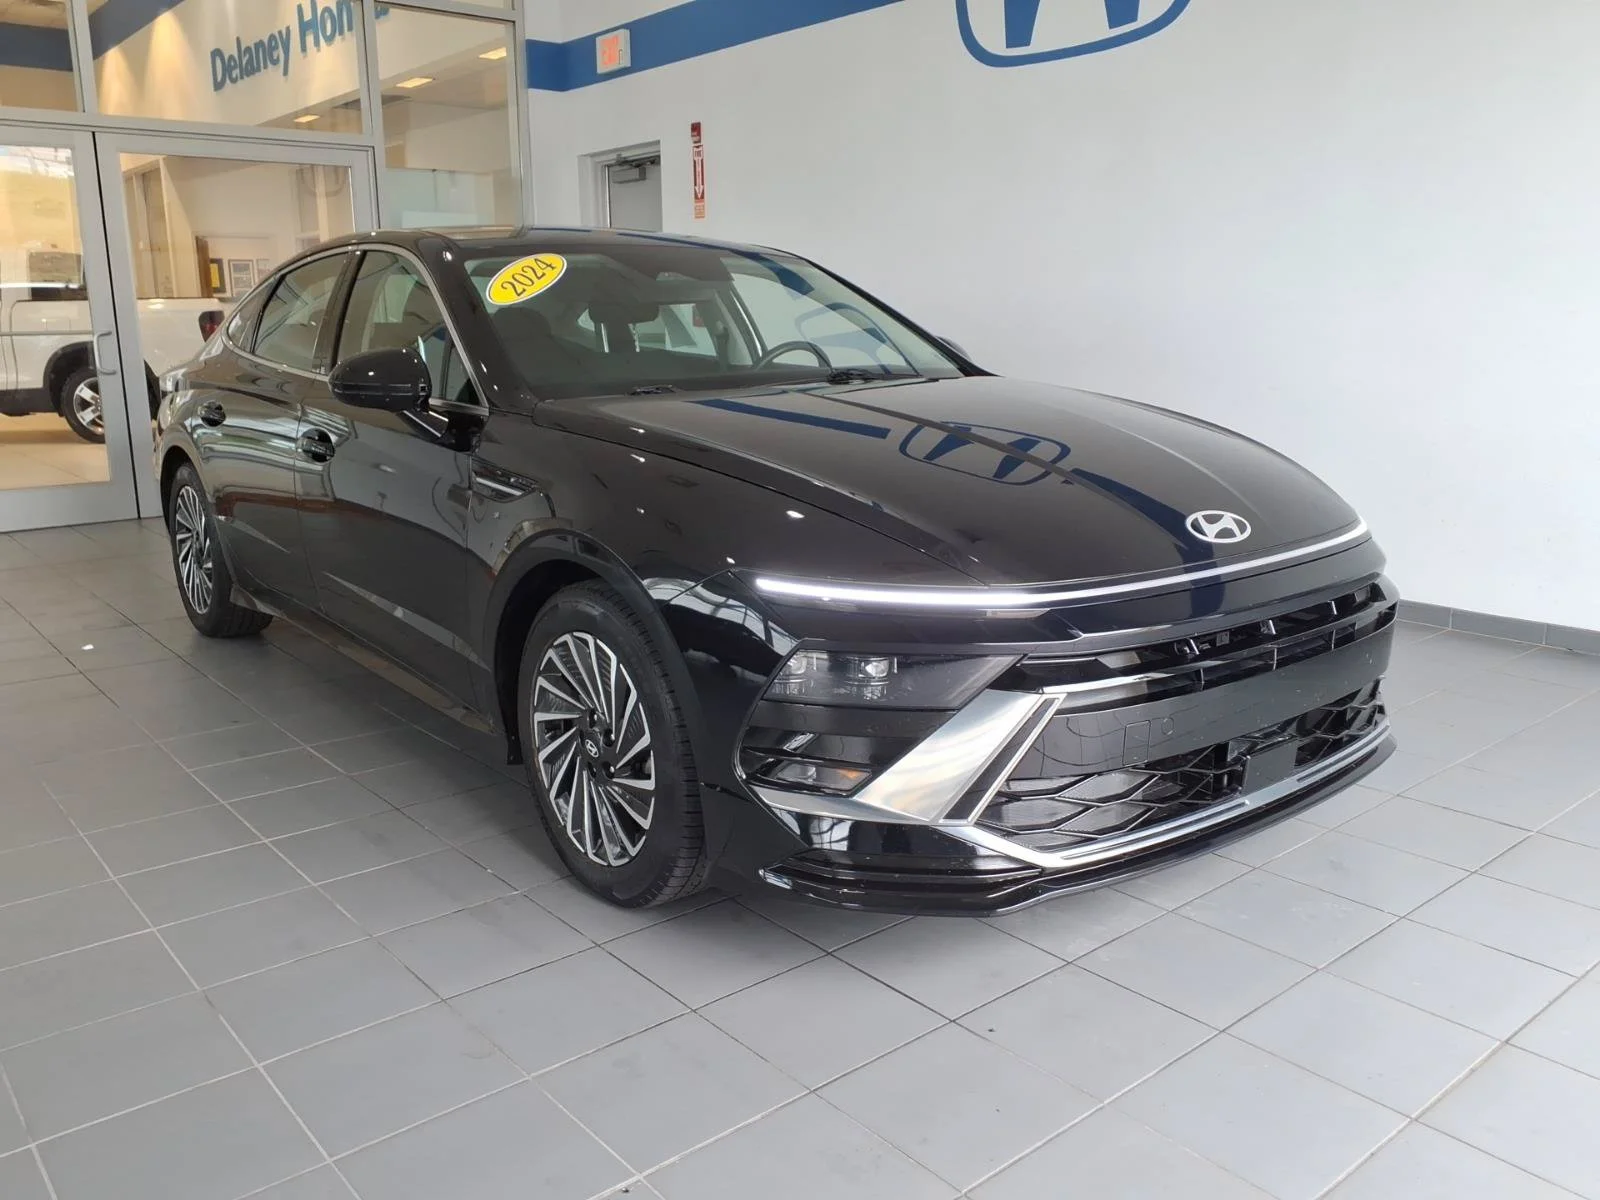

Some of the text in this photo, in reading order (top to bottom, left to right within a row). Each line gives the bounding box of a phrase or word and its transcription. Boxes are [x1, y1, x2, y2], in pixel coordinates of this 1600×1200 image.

[210, 0, 389, 92] Delaney Hon
[501, 258, 556, 296] 2024
